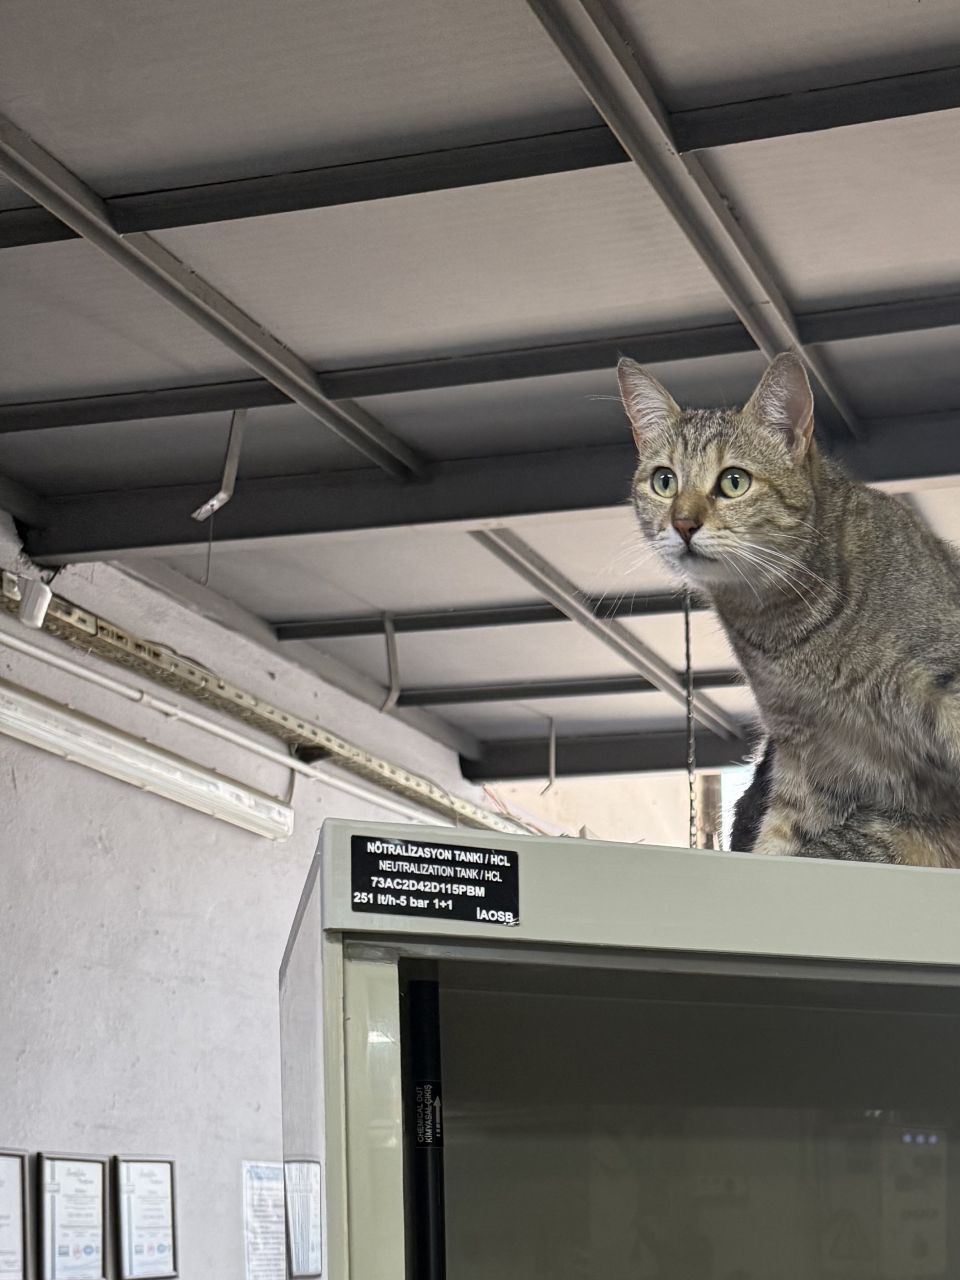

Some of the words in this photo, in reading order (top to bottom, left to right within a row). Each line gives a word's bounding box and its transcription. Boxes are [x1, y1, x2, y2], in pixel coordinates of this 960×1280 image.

[454, 850, 484, 864] TANKI
[490, 854, 511, 867] HCL
[379, 860, 454, 878] NEUTRALIZATION
[455, 867, 479, 880] TANK
[484, 870, 503, 882] HCL
[370, 876, 486, 898] 73AC2D42D115PBM
[353, 891, 374, 904] 251
[377, 893, 408, 907] lt/h-5
[409, 895, 429, 909] bar
[433, 898, 453, 910] 1+1
